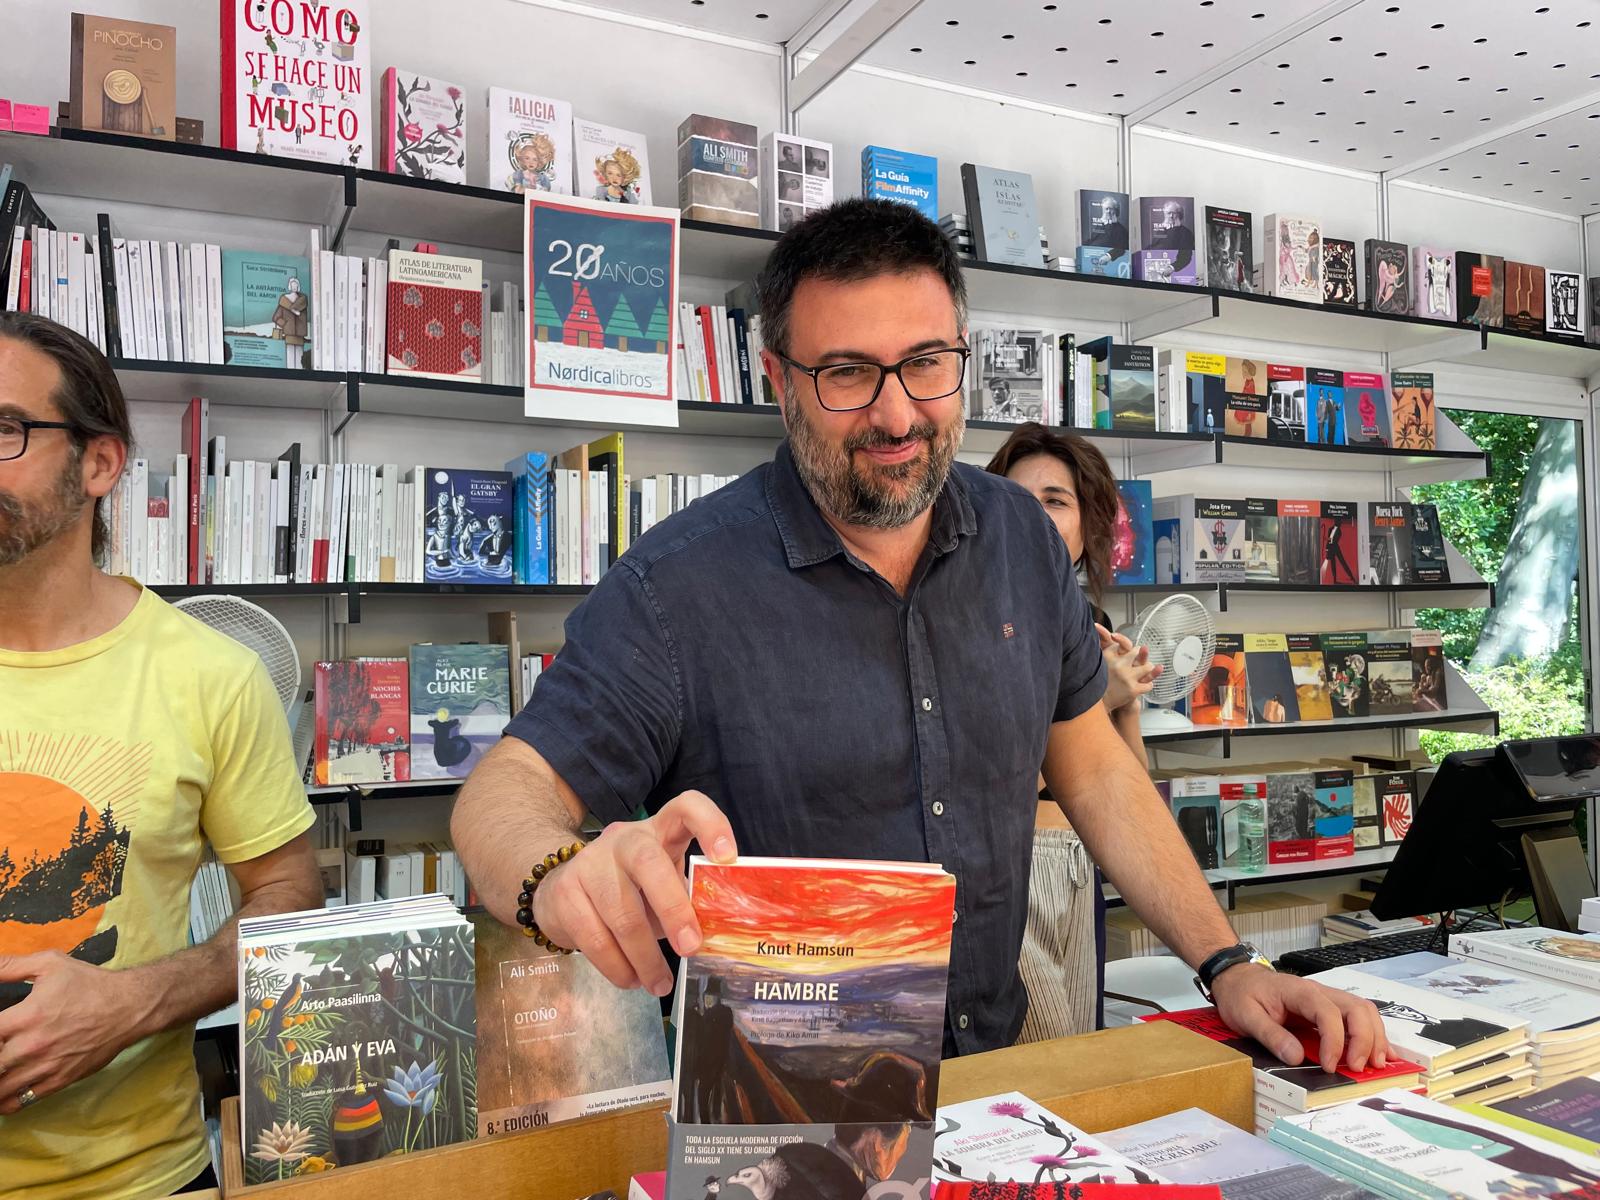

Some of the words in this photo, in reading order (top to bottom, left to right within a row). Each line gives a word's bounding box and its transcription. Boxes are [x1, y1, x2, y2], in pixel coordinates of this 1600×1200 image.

[94, 30, 163, 51] PINOCHO
[245, 51, 268, 80] SE
[274, 55, 328, 89] HACE
[333, 63, 361, 94] UN
[246, 93, 359, 141] MUSEO
[514, 97, 556, 121] ALICIA
[719, 148, 748, 163] SMITH
[876, 169, 887, 178] La
[399, 266, 462, 281] LATINOAMERICANA
[400, 258, 421, 267] ATLAS
[421, 260, 431, 269] DE
[432, 262, 473, 274] LITERATURA
[600, 261, 665, 288] AÑOS
[548, 361, 653, 390] Nørdicalibros
[435, 667, 488, 681] MARIE
[427, 681, 477, 694] CURIE
[757, 941, 792, 956] Knut
[796, 942, 855, 957] Hamsun
[510, 966, 525, 978] Ali
[528, 962, 560, 976] Smith
[754, 981, 839, 1001] HAMBRE
[301, 998, 327, 1012] Arto
[328, 991, 382, 1008] Paasilinna
[514, 1006, 558, 1025] OTOÑO
[301, 1043, 347, 1066] ADÁN
[351, 1042, 363, 1058] Y
[366, 1038, 396, 1057] EVA
[504, 1109, 549, 1132] EDICIÓN
[686, 1135, 702, 1144] TODA
[703, 1136, 711, 1144] LA
[712, 1136, 738, 1144] ESCUELA
[740, 1136, 769, 1144] MODERNA
[770, 1136, 778, 1144] DE
[779, 1134, 804, 1144] FICCIÓN
[940, 1149, 955, 1158] LA
[954, 1140, 994, 1154] SOMBRA
[994, 1136, 1011, 1145] DEL
[1011, 1127, 1043, 1140] CARDO
[685, 1145, 696, 1154] DEL
[697, 1146, 716, 1154] SIGLO
[717, 1146, 725, 1154] XX
[727, 1146, 743, 1154] TIENE
[744, 1146, 752, 1154] SU
[753, 1146, 777, 1154] ORIGEN
[684, 1156, 693, 1164] EN
[694, 1156, 720, 1164] HAMSUN
